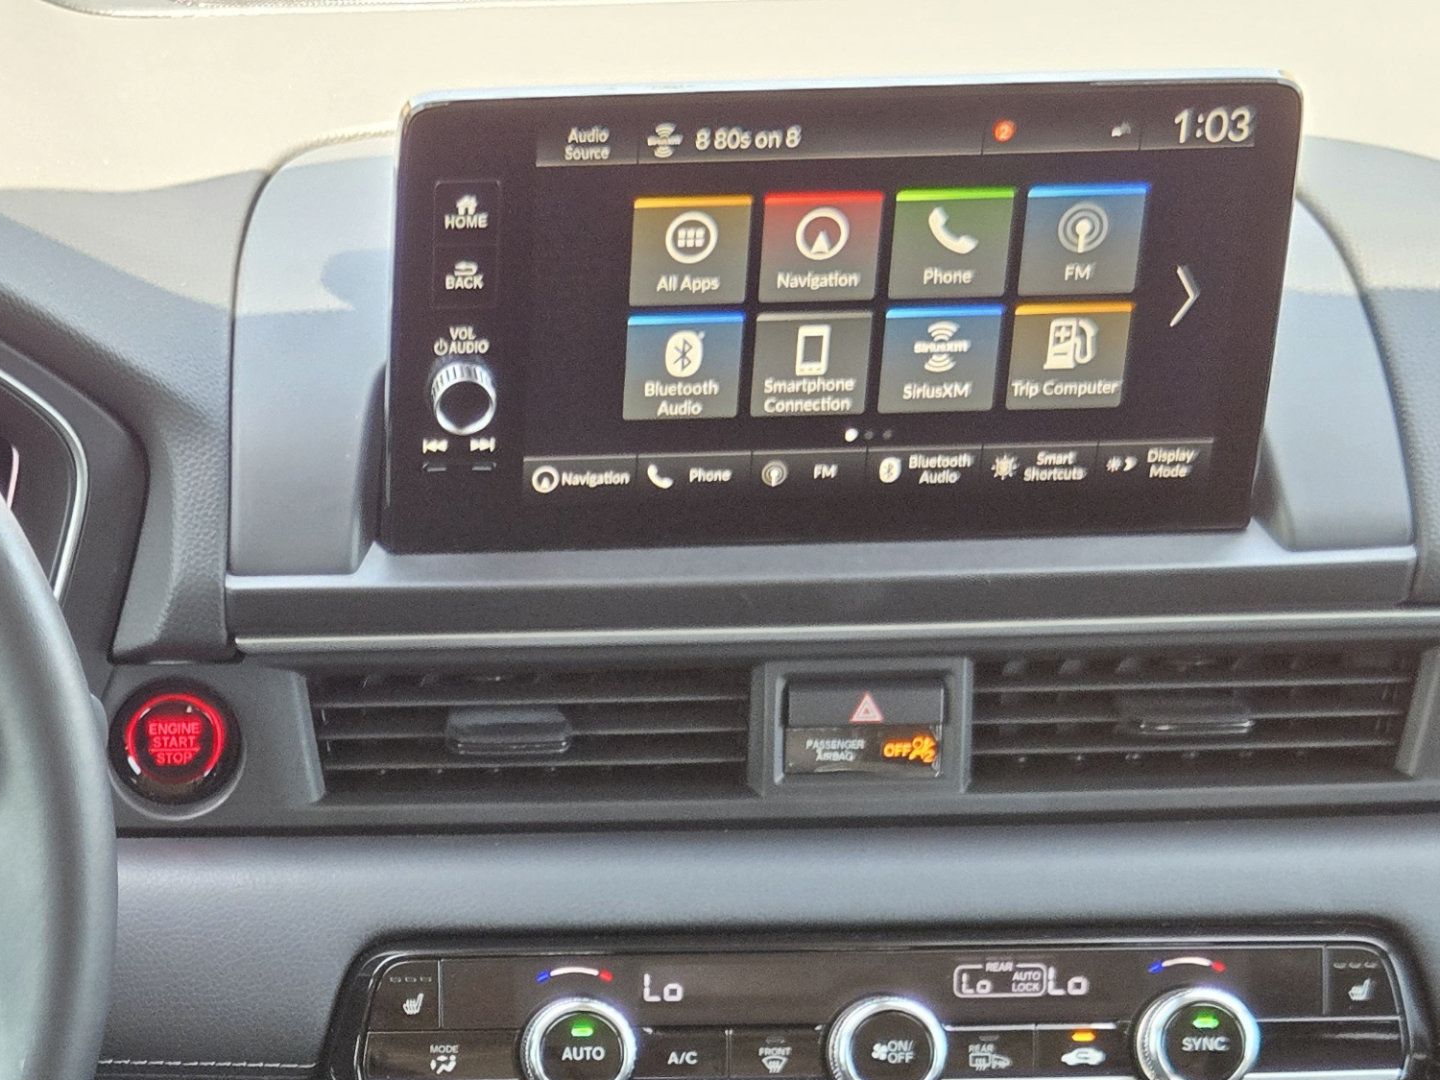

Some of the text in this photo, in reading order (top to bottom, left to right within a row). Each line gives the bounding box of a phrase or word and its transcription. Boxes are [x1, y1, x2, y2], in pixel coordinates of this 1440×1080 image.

[1174, 106, 1252, 143] 1:03
[568, 126, 609, 143] Audio
[695, 128, 710, 150] 8
[713, 127, 752, 150] 80s
[755, 130, 783, 149] on
[785, 125, 801, 148] 8
[565, 146, 610, 160] Source
[444, 213, 488, 229] HOME
[923, 267, 975, 284] Phone
[1065, 263, 1095, 280] FM
[446, 275, 483, 289] BACK
[656, 275, 720, 293] All Apps
[776, 272, 861, 290] Navigation
[450, 327, 476, 340] VOL
[449, 339, 489, 354] AUDIO
[644, 379, 719, 397] Bluetooth
[764, 377, 856, 395] Smartphone
[903, 381, 972, 399] SiriusXM
[1011, 378, 1122, 398] Trip Computer
[657, 400, 702, 416] Audio
[764, 397, 851, 413] Connection
[909, 454, 973, 469] Bluetooth
[1036, 451, 1077, 466] Smart
[1147, 449, 1198, 465] Display
[689, 467, 732, 483] Phone
[813, 464, 838, 479] FM
[918, 469, 960, 484] Audio
[1023, 467, 1086, 482] Shortcuts
[1149, 465, 1191, 479] Mode
[561, 471, 630, 488] Navigation
[149, 722, 200, 735] ENGINE
[153, 736, 196, 747] START
[806, 739, 865, 750] PASSENGER
[816, 750, 855, 761] AIRBAG
[883, 743, 911, 757] OFF
[157, 753, 193, 764] STOP
[985, 962, 1013, 972] REAR
[1012, 971, 1041, 980] AUTO
[1011, 982, 1040, 993] LOCK
[430, 1045, 458, 1055] MODE
[759, 1047, 791, 1056] FRONT
[887, 1040, 913, 1053] ON/
[968, 1044, 994, 1052] REAR
[1181, 1036, 1228, 1052] SYNC
[562, 1046, 605, 1062] AUTO
[668, 1051, 698, 1065] A/C
[887, 1052, 914, 1063] OFF
